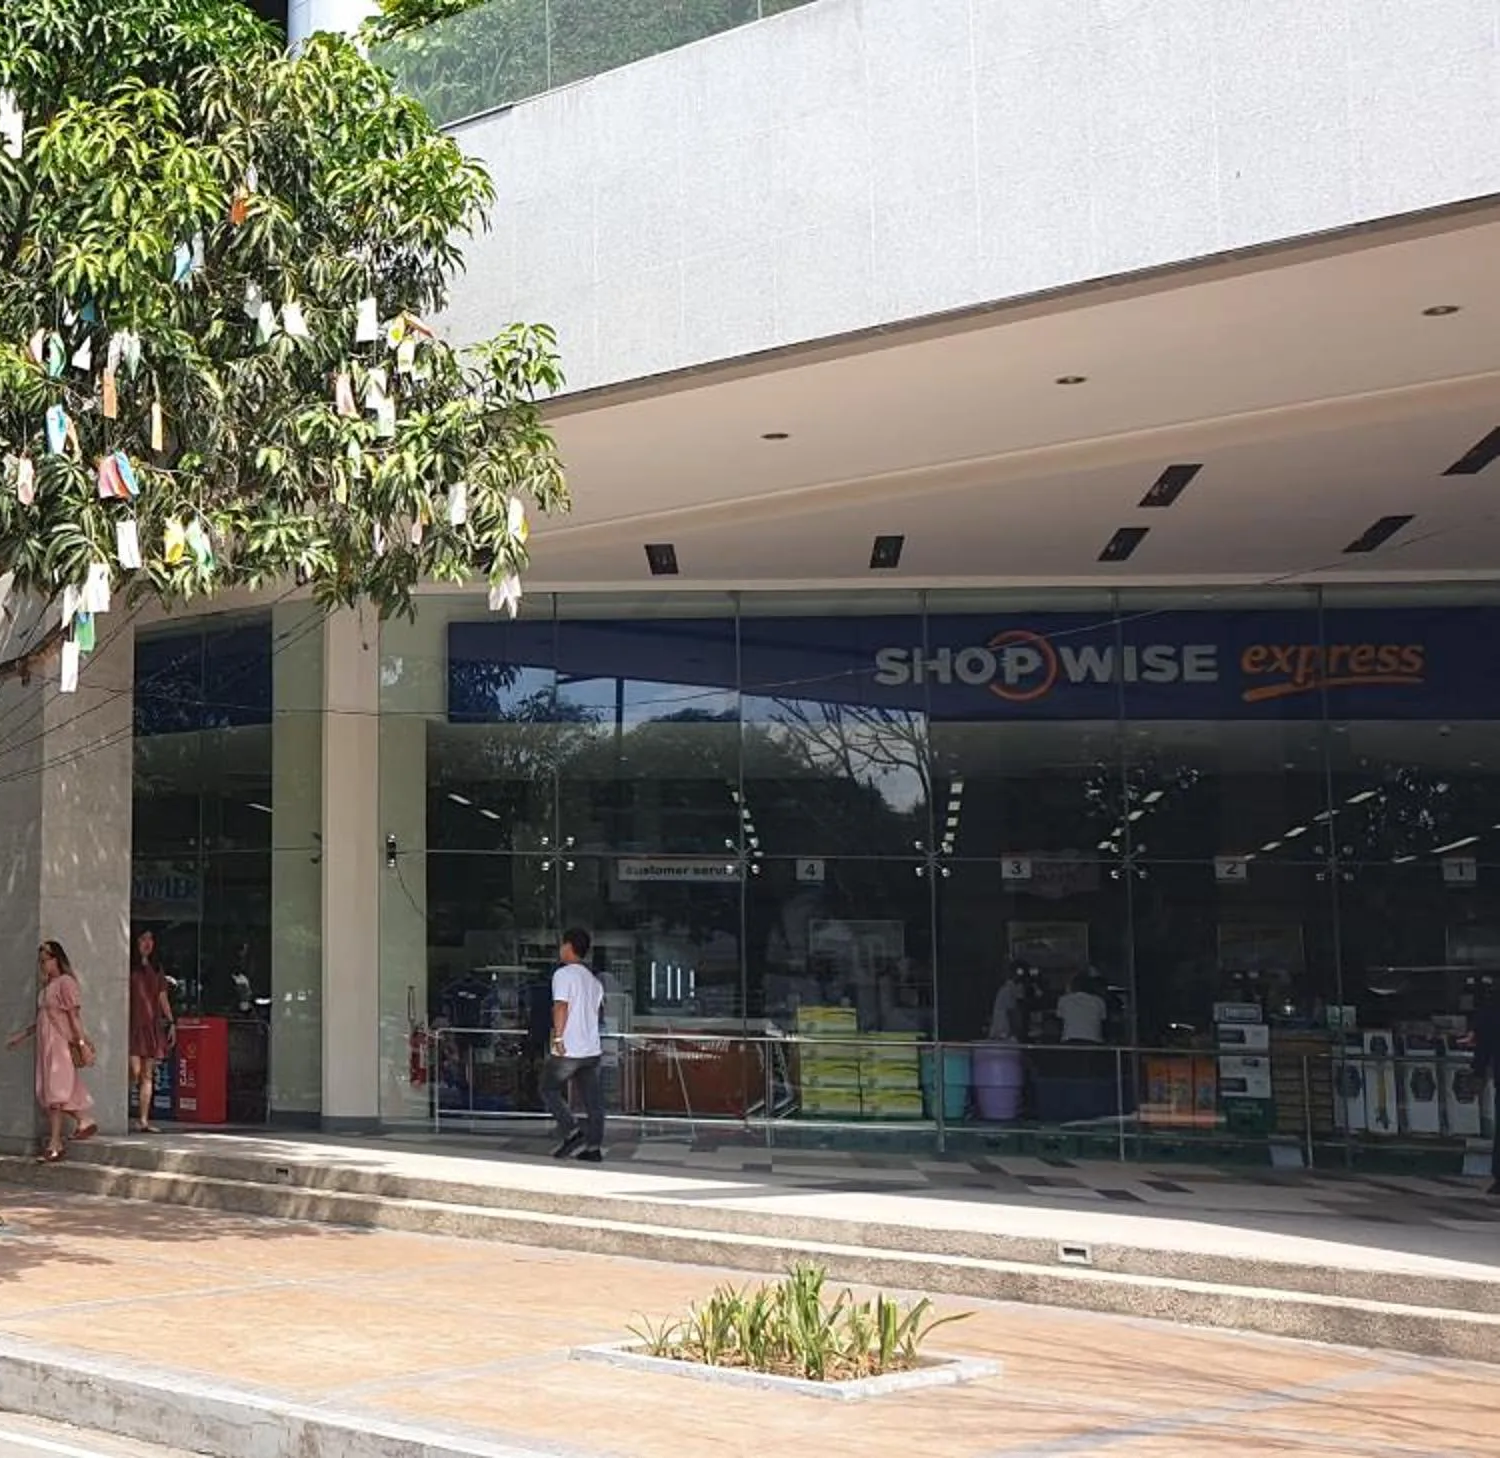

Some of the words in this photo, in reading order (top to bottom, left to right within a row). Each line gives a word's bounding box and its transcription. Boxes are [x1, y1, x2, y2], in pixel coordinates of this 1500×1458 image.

[1240, 643, 1425, 685] express
[625, 864, 687, 876] customer
[693, 864, 742, 876] servie
[804, 863, 816, 876] 4
[1011, 861, 1021, 876] 3
[1226, 861, 1238, 875] 2
